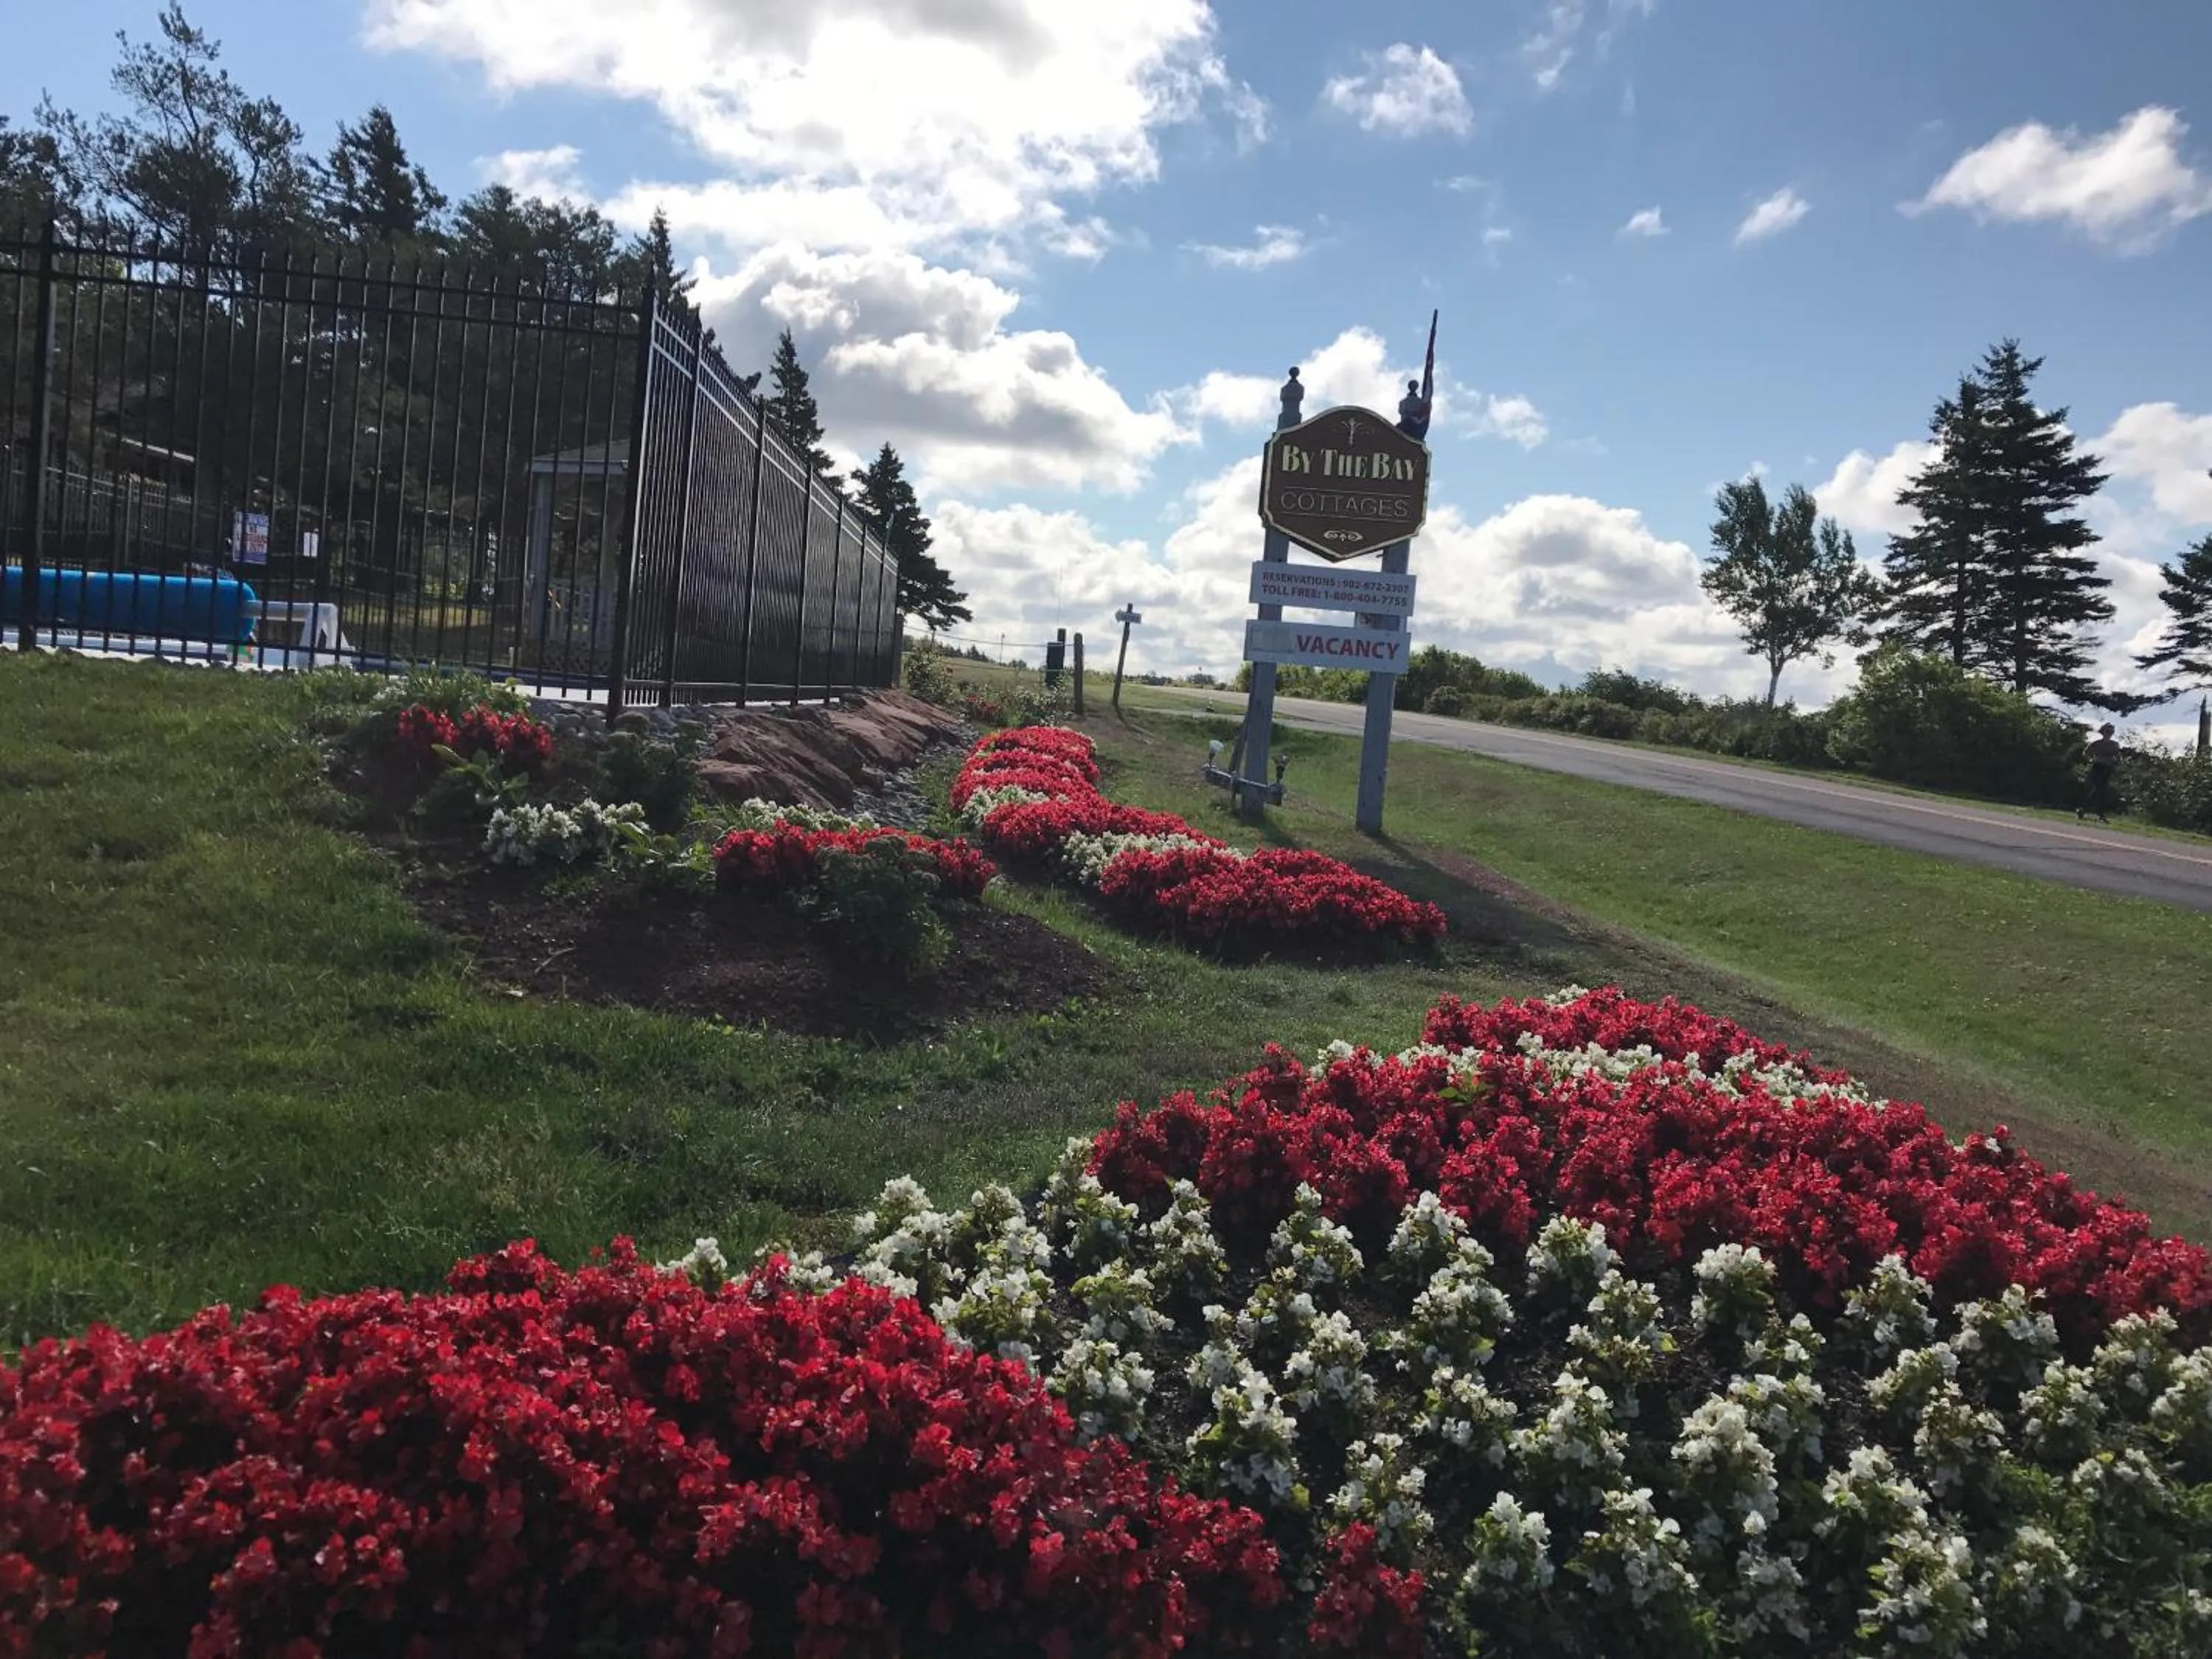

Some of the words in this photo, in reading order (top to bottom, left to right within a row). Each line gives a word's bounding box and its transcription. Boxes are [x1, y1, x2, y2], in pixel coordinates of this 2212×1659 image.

[1281, 444, 1315, 474] BY
[1321, 448, 1368, 478] THE
[1371, 452, 1419, 481] BAY
[1281, 491, 1409, 518] COTTAGES
[1262, 583, 1290, 596] TOLL
[1291, 587, 1321, 599] FREE:
[1295, 634, 1400, 660] VACANCY
